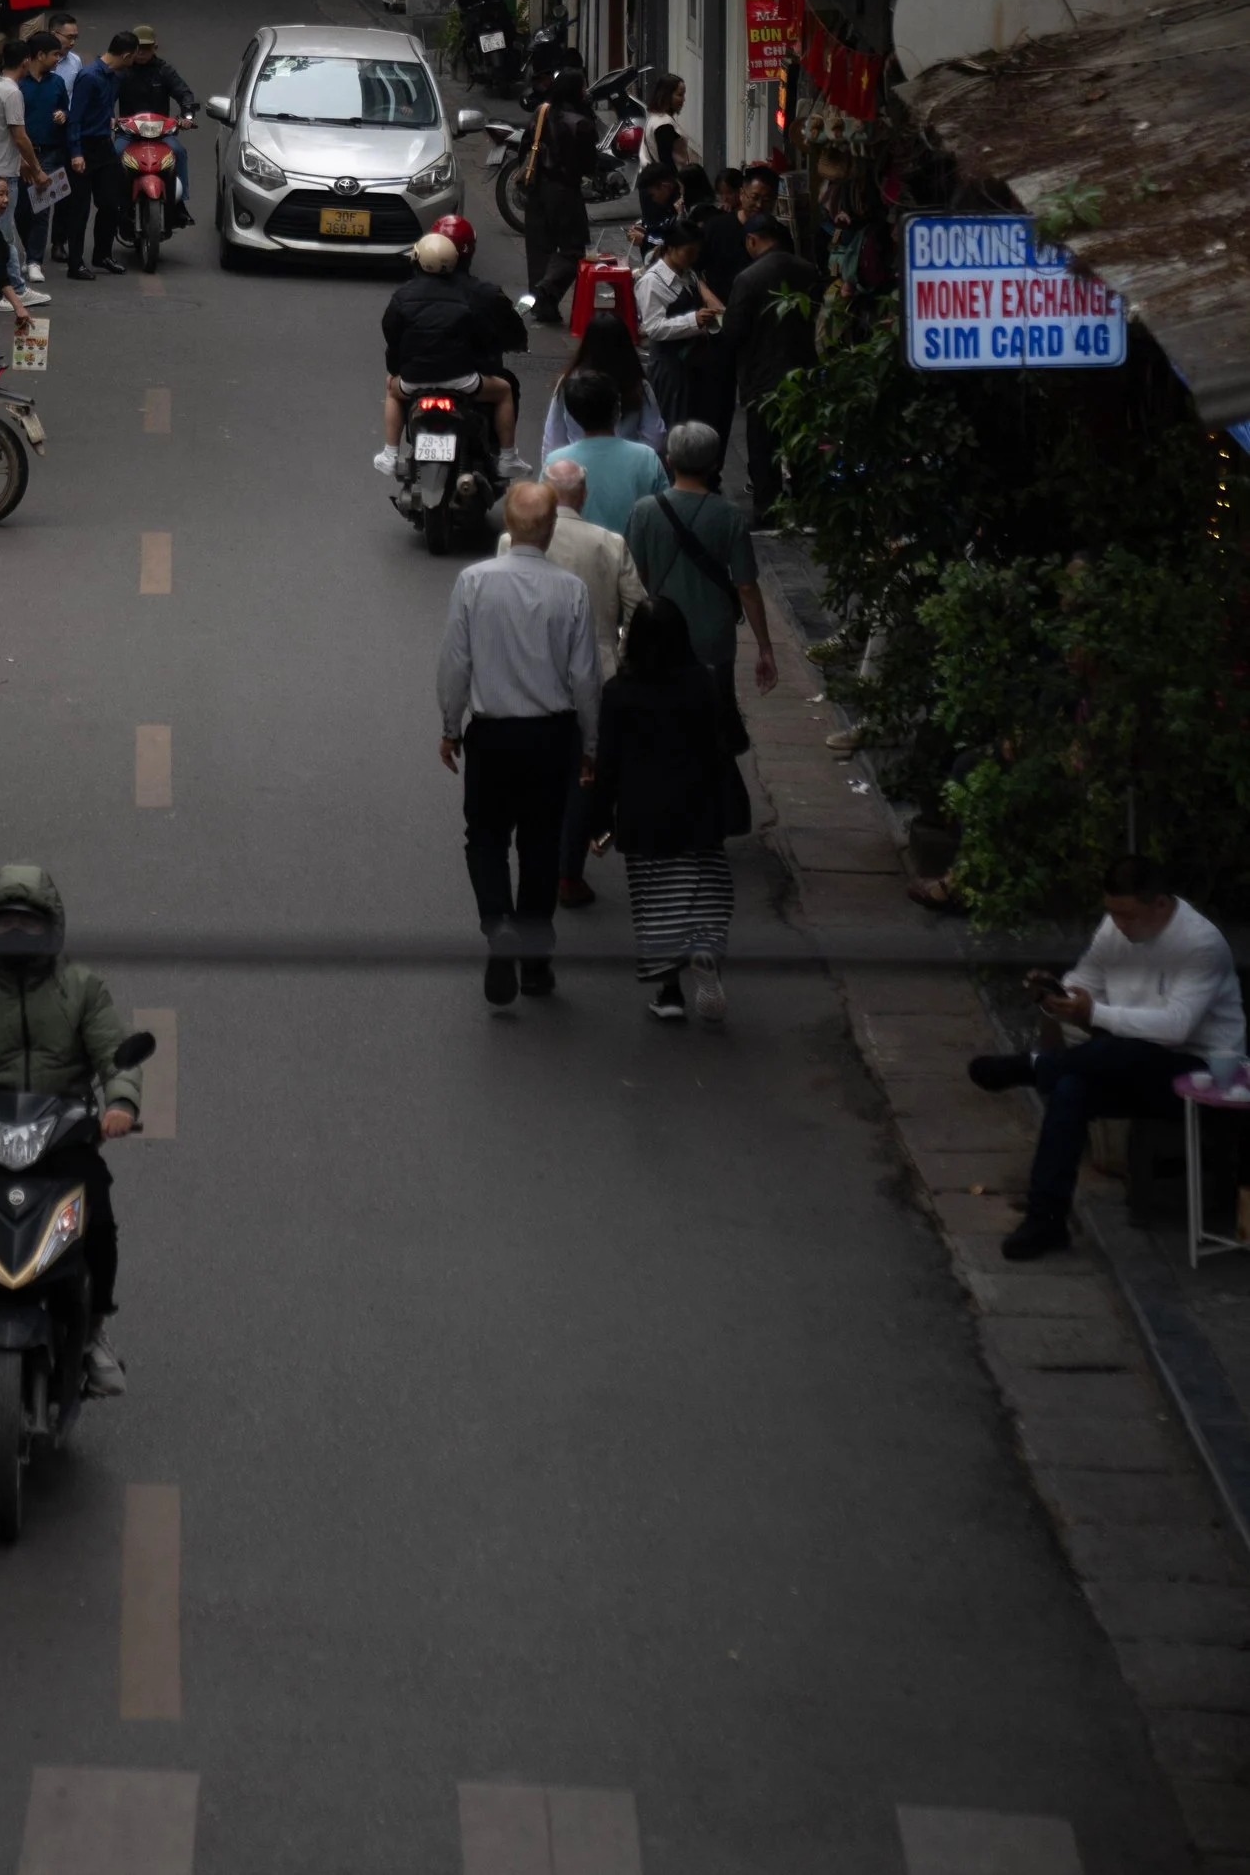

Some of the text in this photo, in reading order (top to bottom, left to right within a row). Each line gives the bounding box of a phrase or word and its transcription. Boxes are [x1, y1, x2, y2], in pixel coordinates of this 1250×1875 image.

[750, 26, 782, 43] BÚN
[913, 223, 1026, 268] BOOKING
[917, 277, 1117, 320] MONEY EXCHANGE
[924, 323, 1111, 360] SIM CARD 4G
